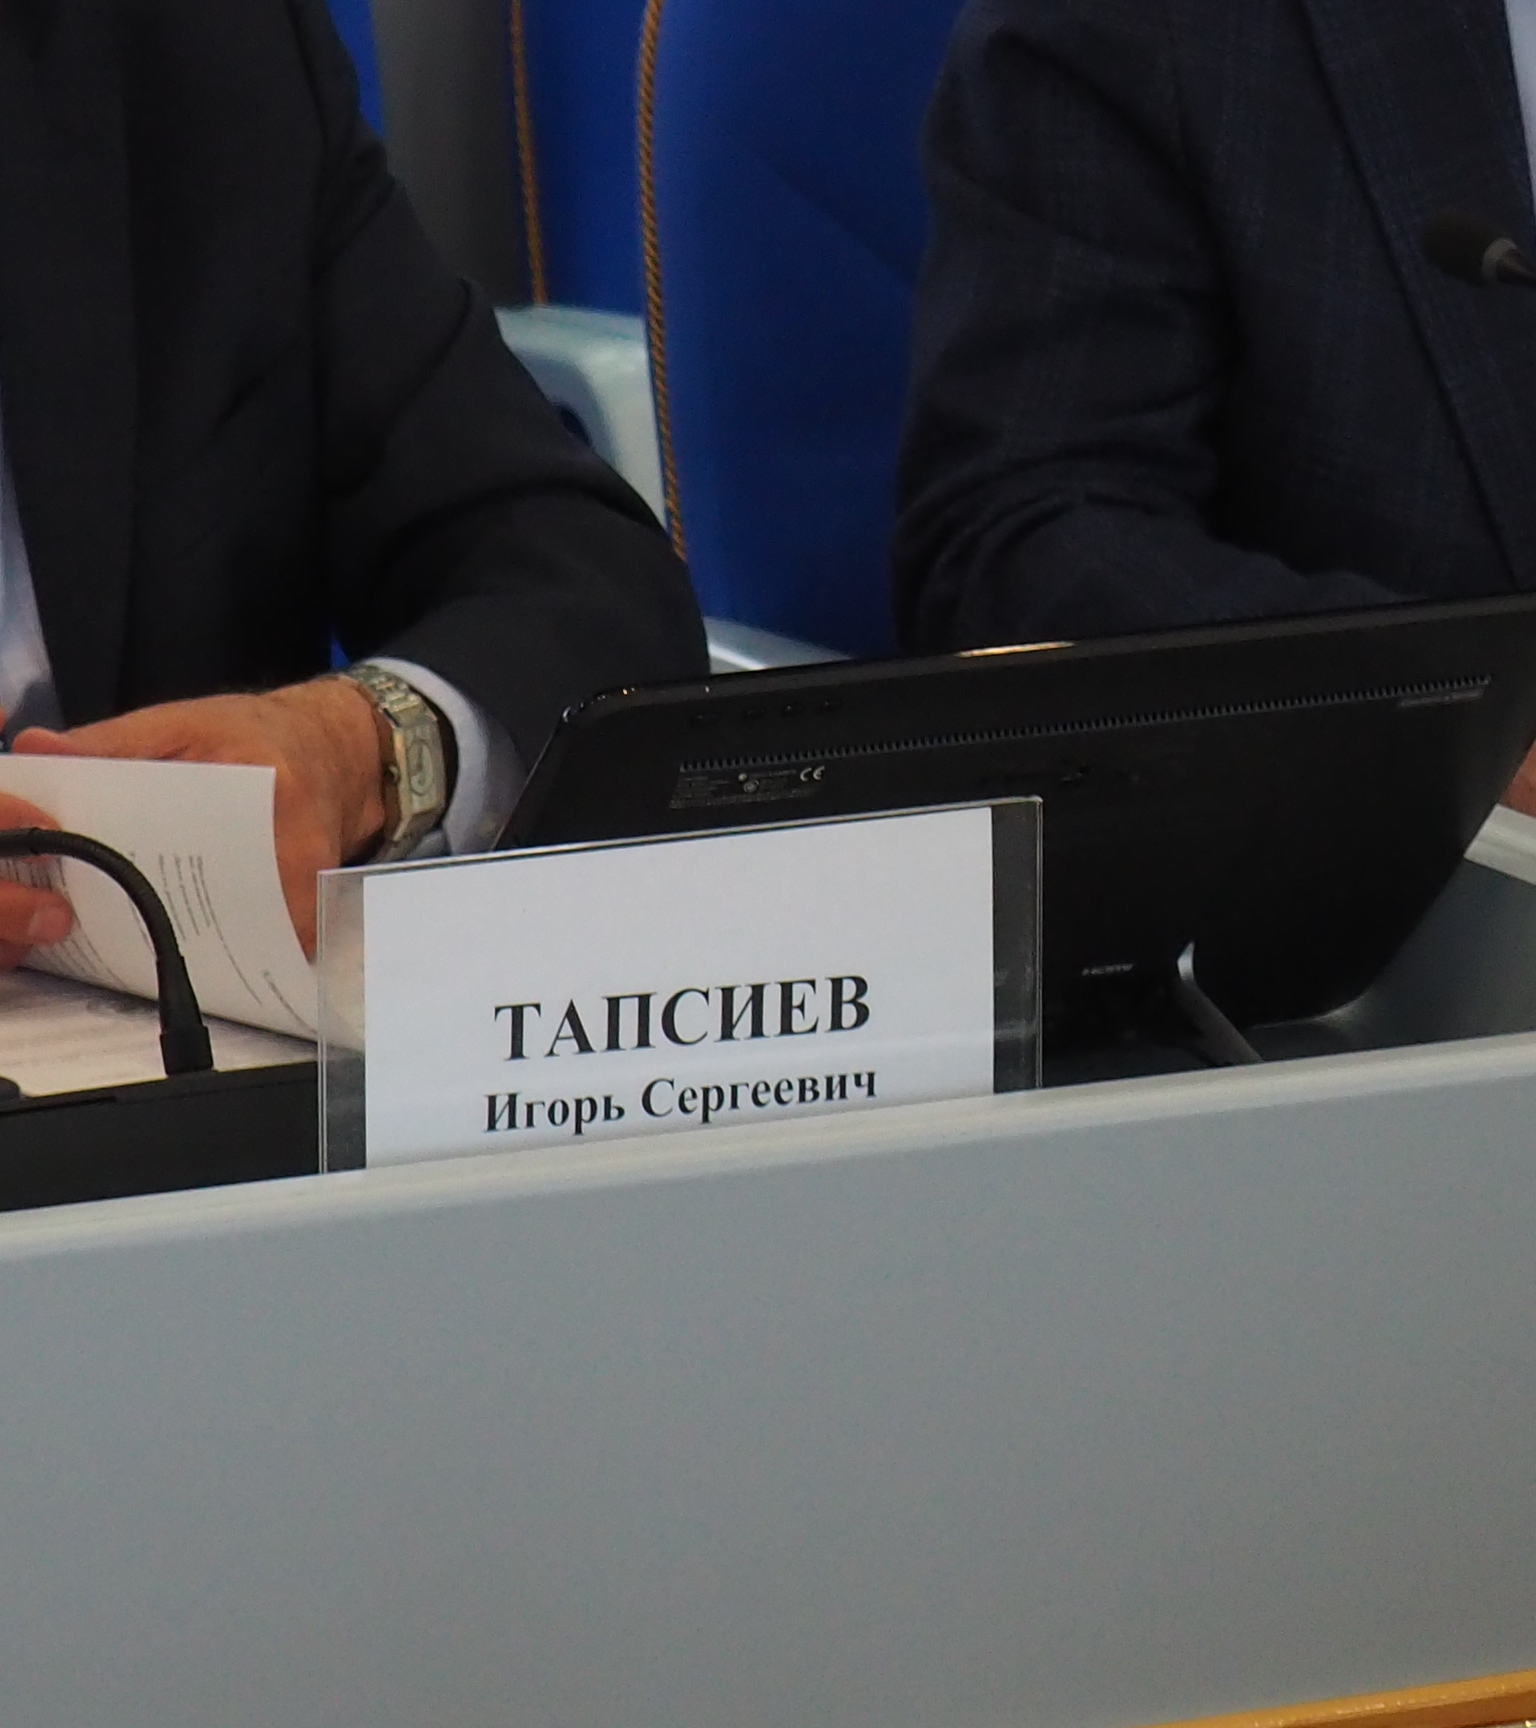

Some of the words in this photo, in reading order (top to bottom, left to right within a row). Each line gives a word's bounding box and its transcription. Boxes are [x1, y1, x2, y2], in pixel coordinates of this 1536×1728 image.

[494, 974, 870, 1062] ТАПСИЕВ
[483, 1091, 626, 1137] Игорь
[641, 1070, 877, 1125] Сергеевич
